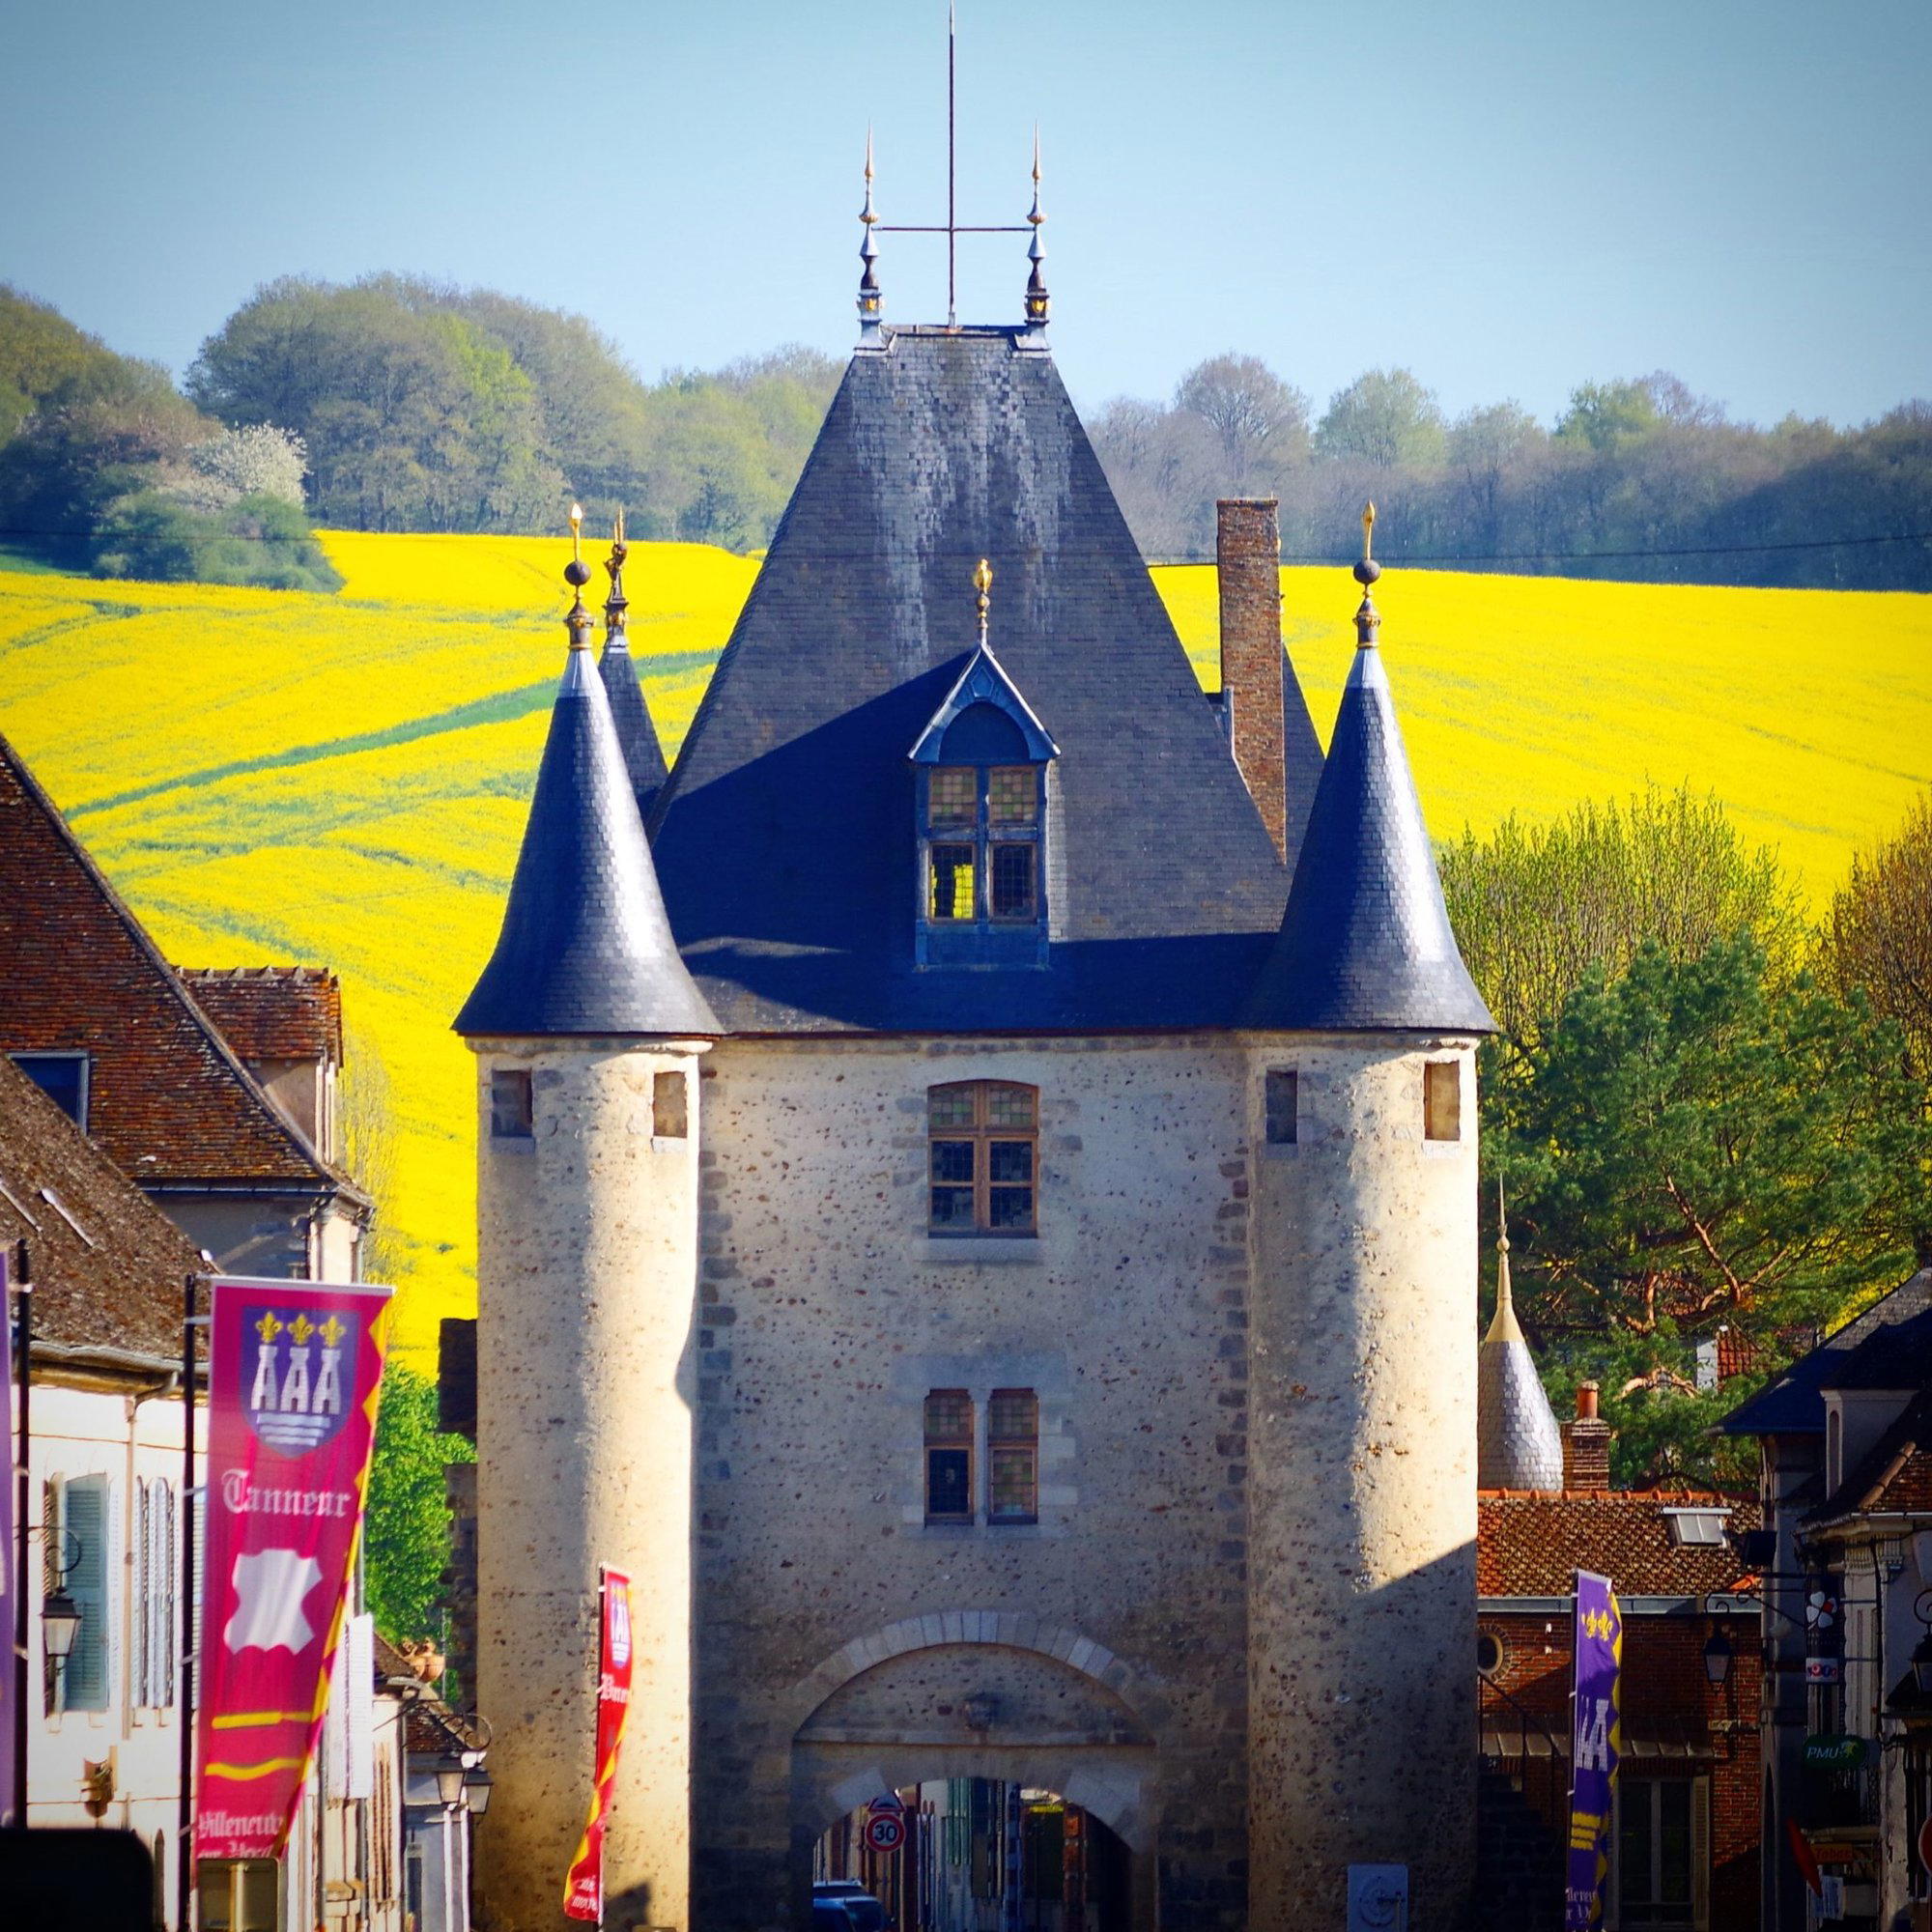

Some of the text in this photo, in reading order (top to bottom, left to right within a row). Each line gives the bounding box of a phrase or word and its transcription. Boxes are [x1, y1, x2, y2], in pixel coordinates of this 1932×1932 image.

[221, 1468, 351, 1518] Tanneur
[1807, 1747, 1839, 1759] PMU
[873, 1824, 898, 1843] 30
